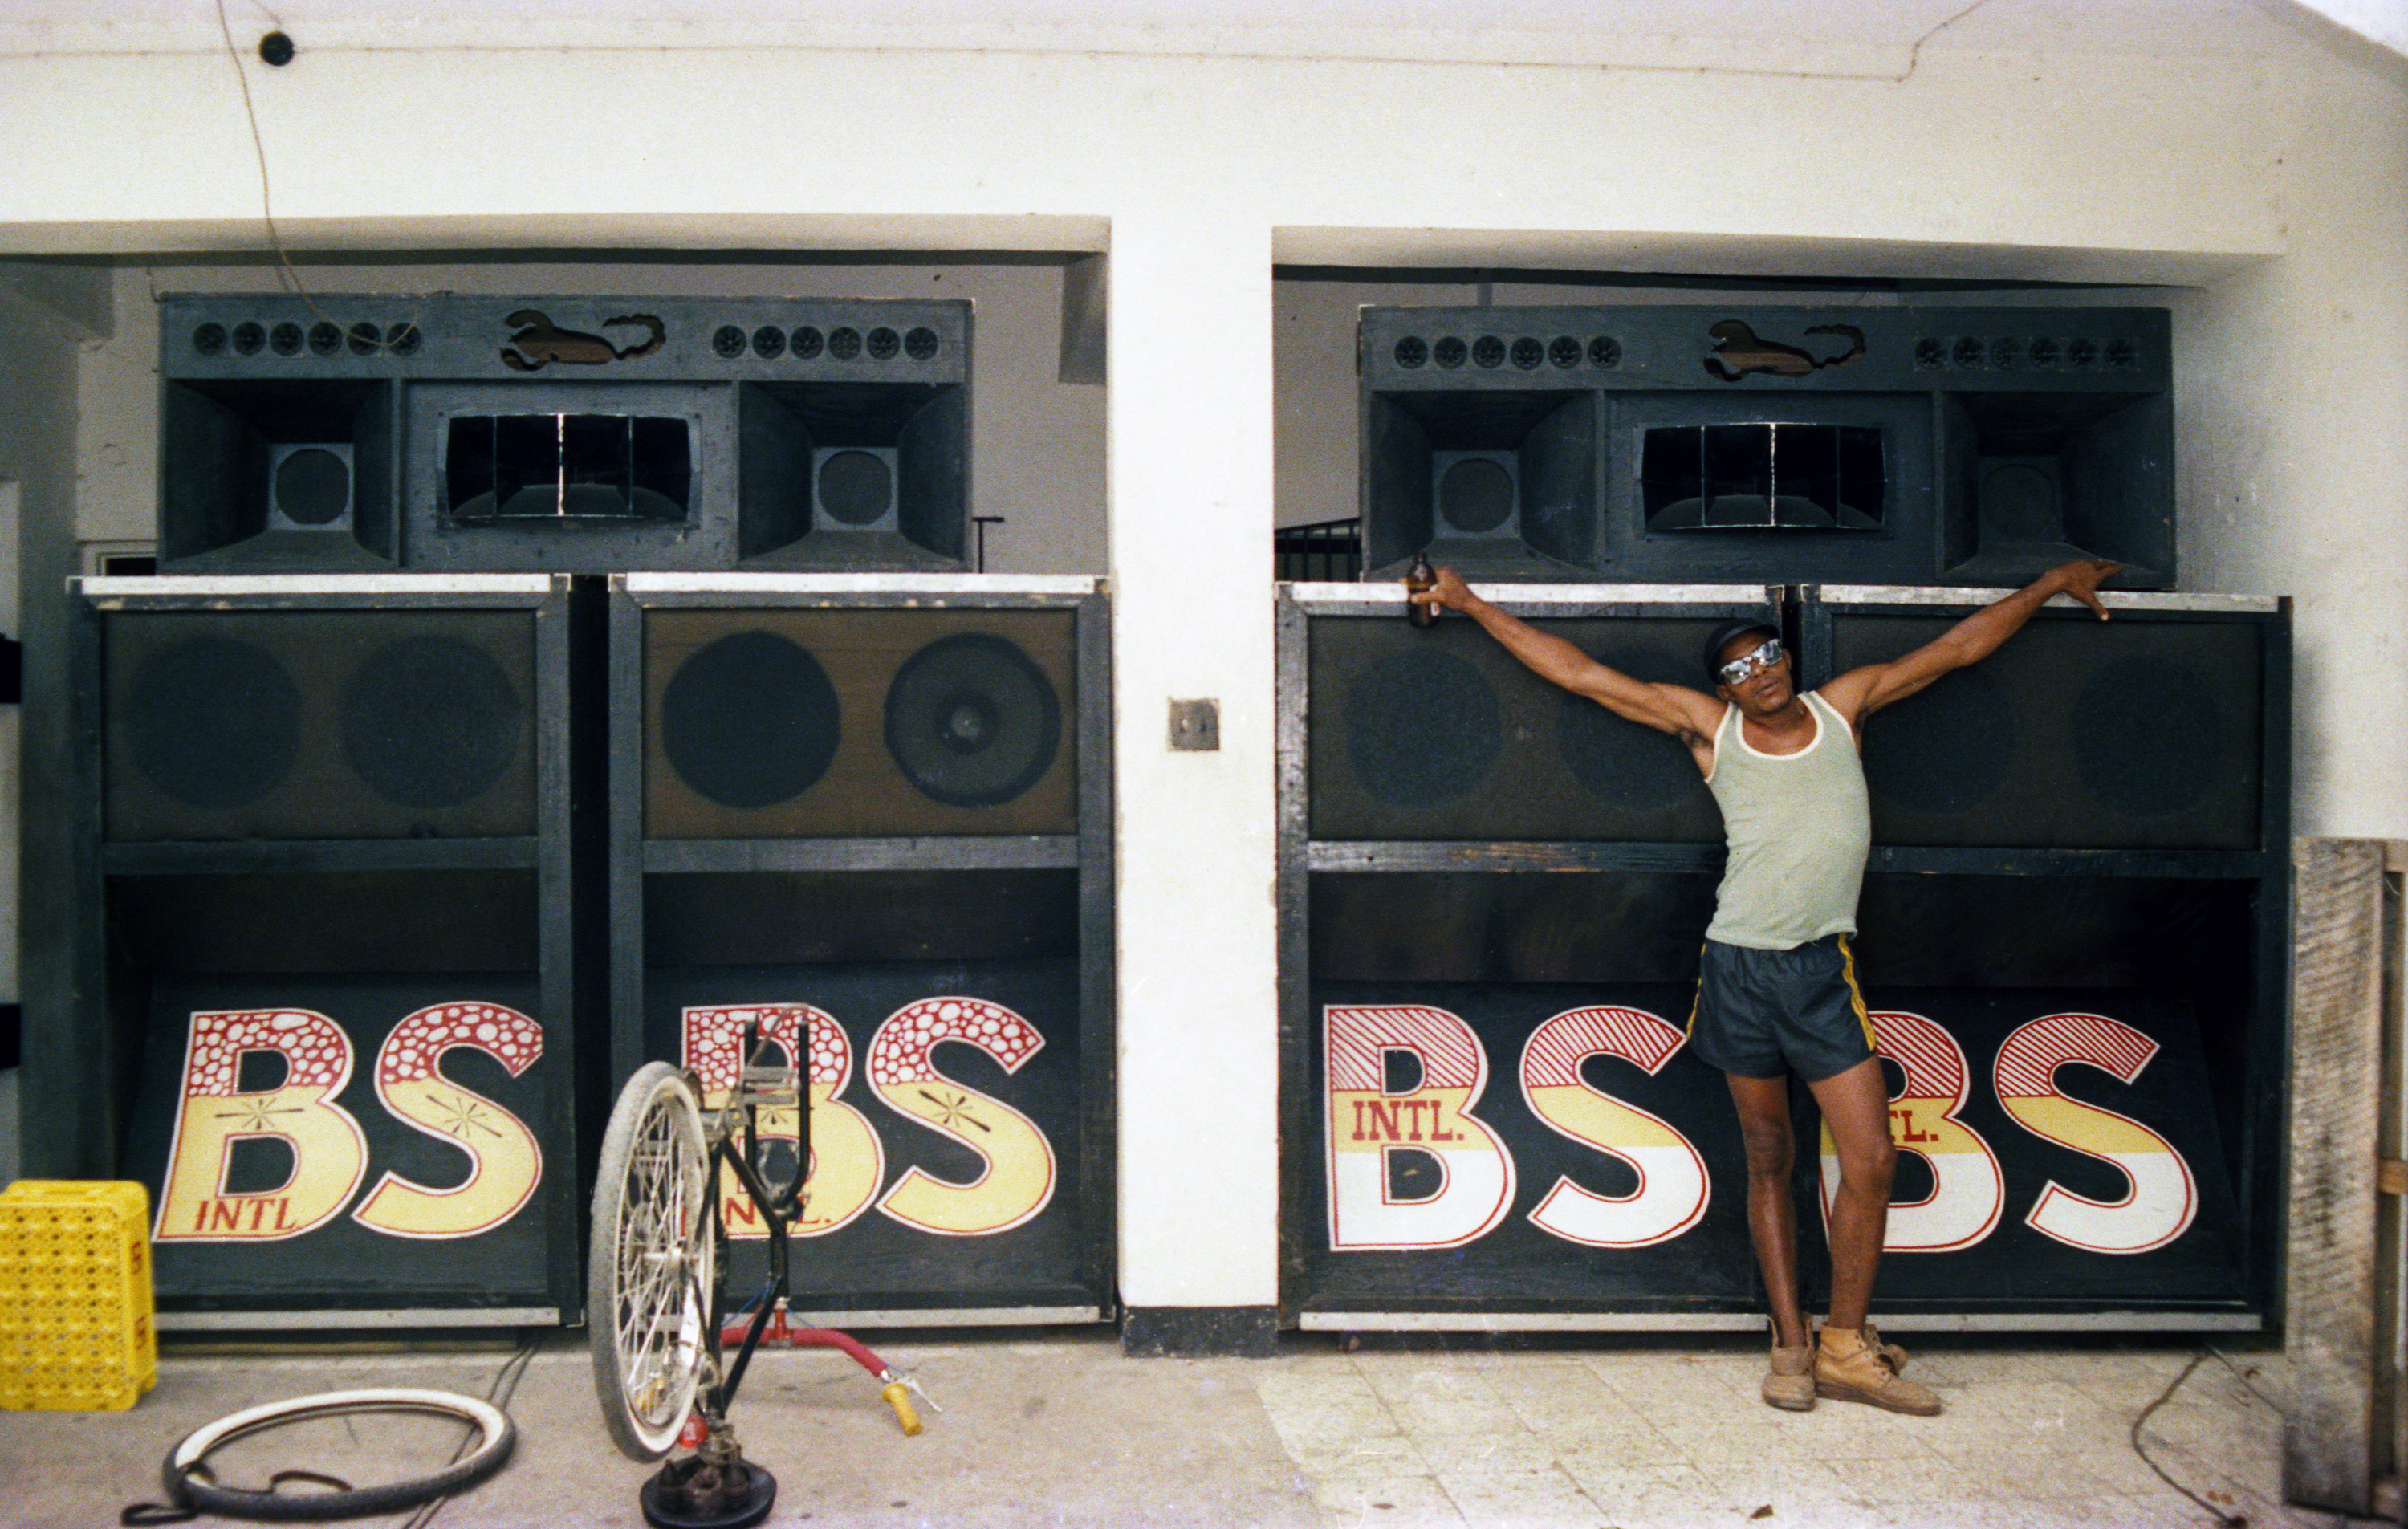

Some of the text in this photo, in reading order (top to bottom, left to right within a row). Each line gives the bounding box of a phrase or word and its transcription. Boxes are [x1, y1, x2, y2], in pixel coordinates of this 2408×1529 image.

[151, 1001, 543, 1242] BS
[680, 995, 1057, 1240] BS
[1323, 1004, 1711, 1252] BS
[1352, 1100, 1466, 1141] INTL.
[1819, 1010, 2199, 1255] BS
